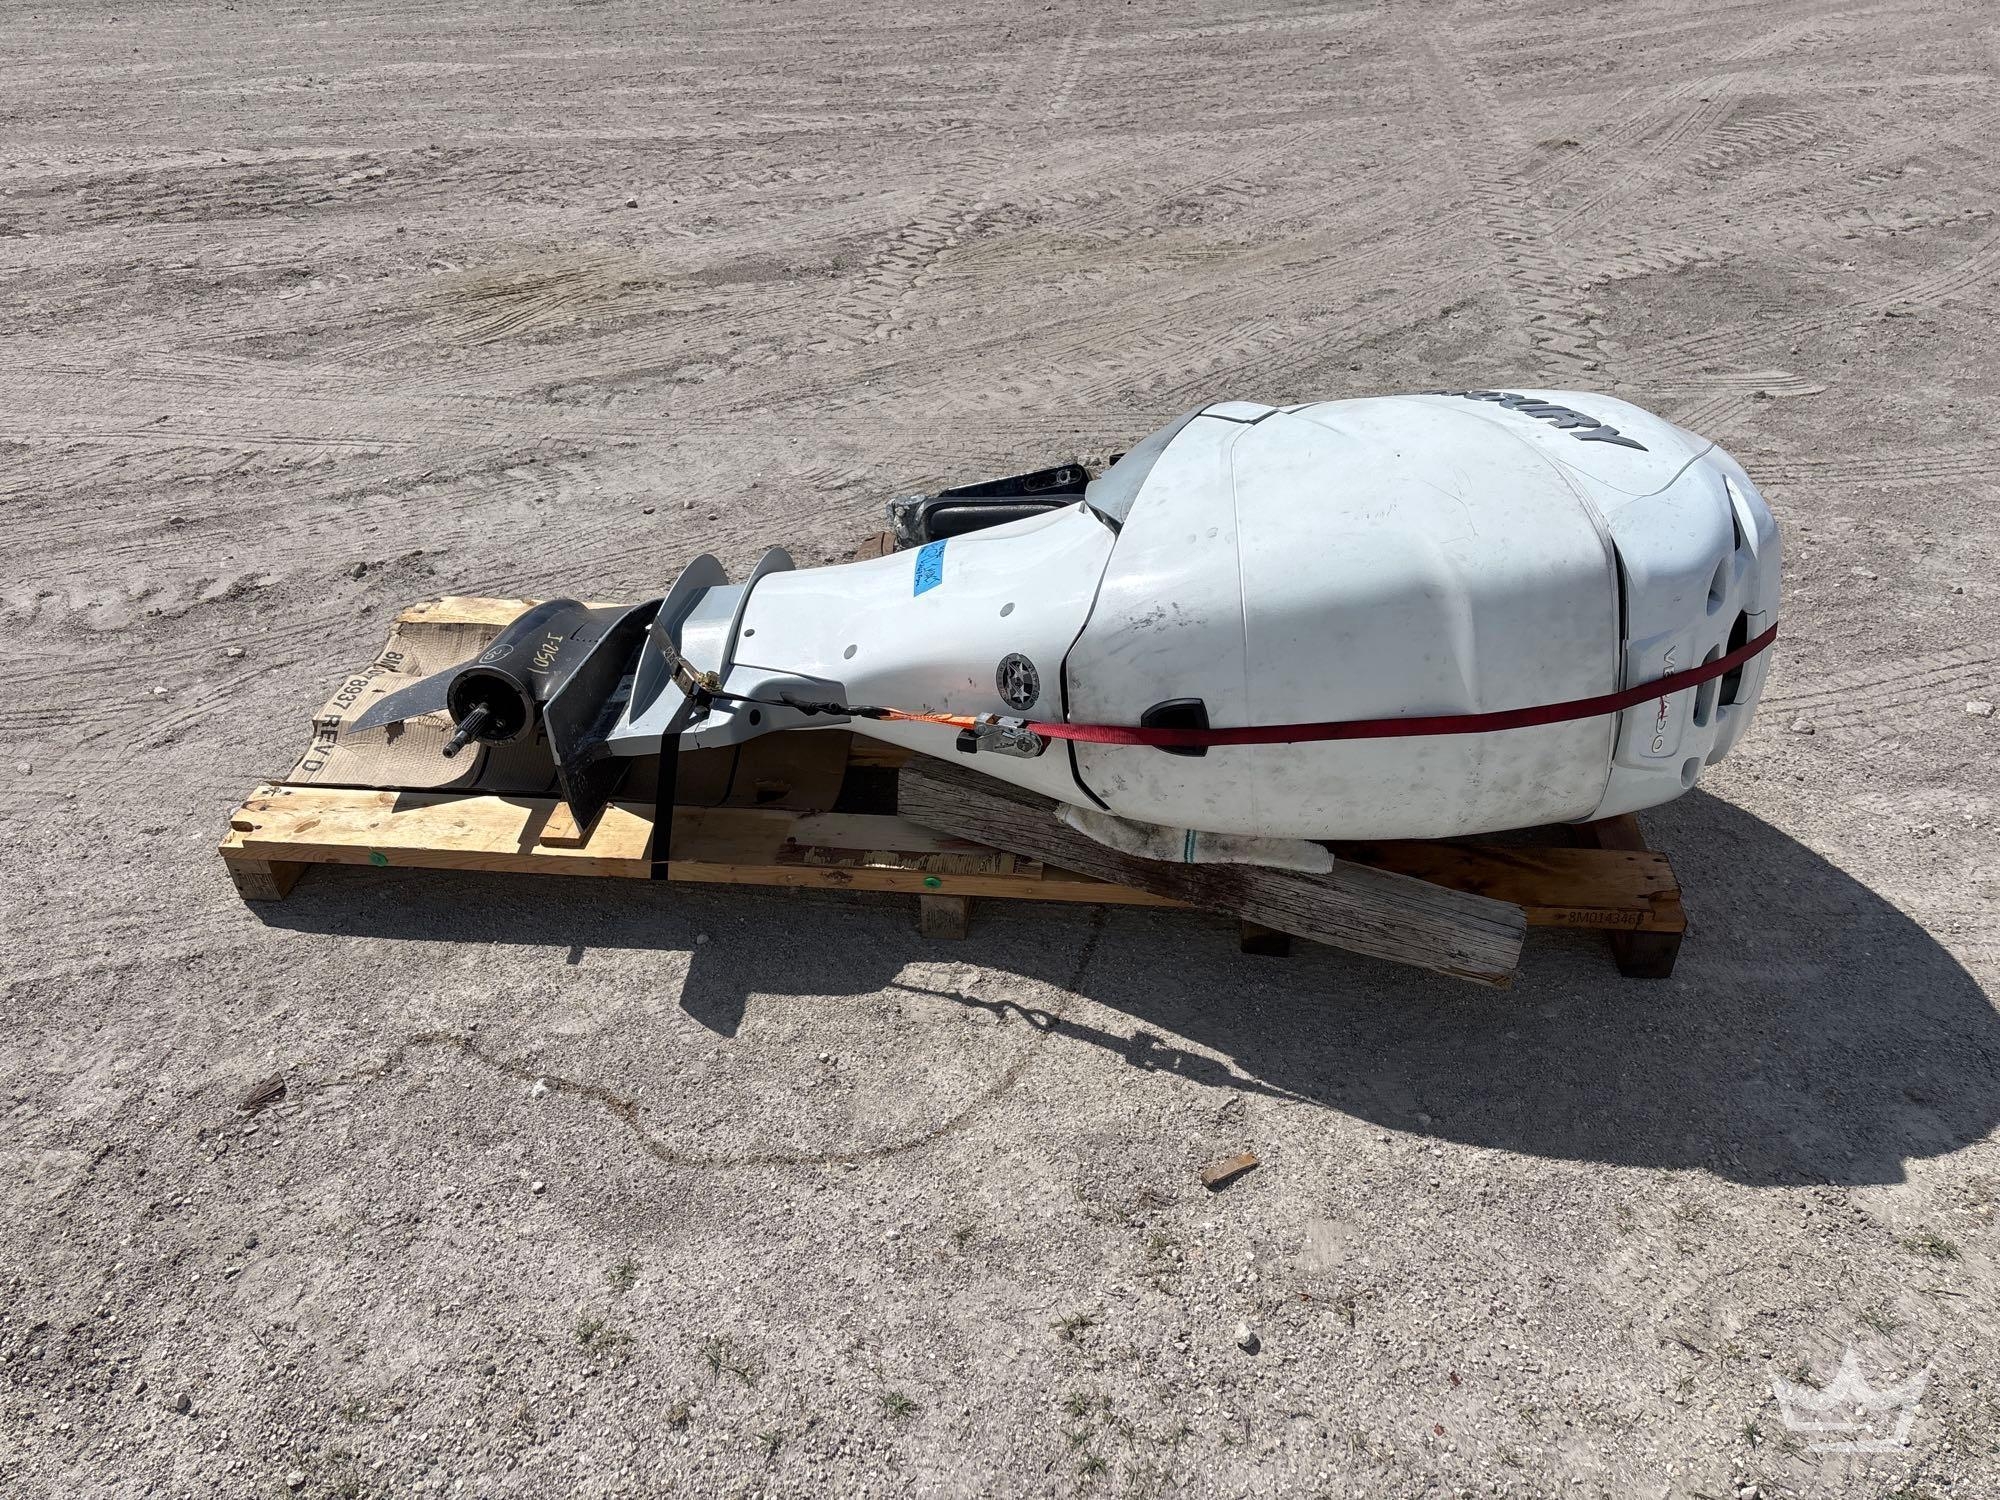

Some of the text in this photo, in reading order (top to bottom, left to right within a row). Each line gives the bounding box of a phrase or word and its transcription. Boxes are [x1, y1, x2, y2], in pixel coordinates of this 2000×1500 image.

[1651, 644, 1677, 754] VEADO
[312, 714, 343, 757] REV
[301, 759, 325, 773] D
